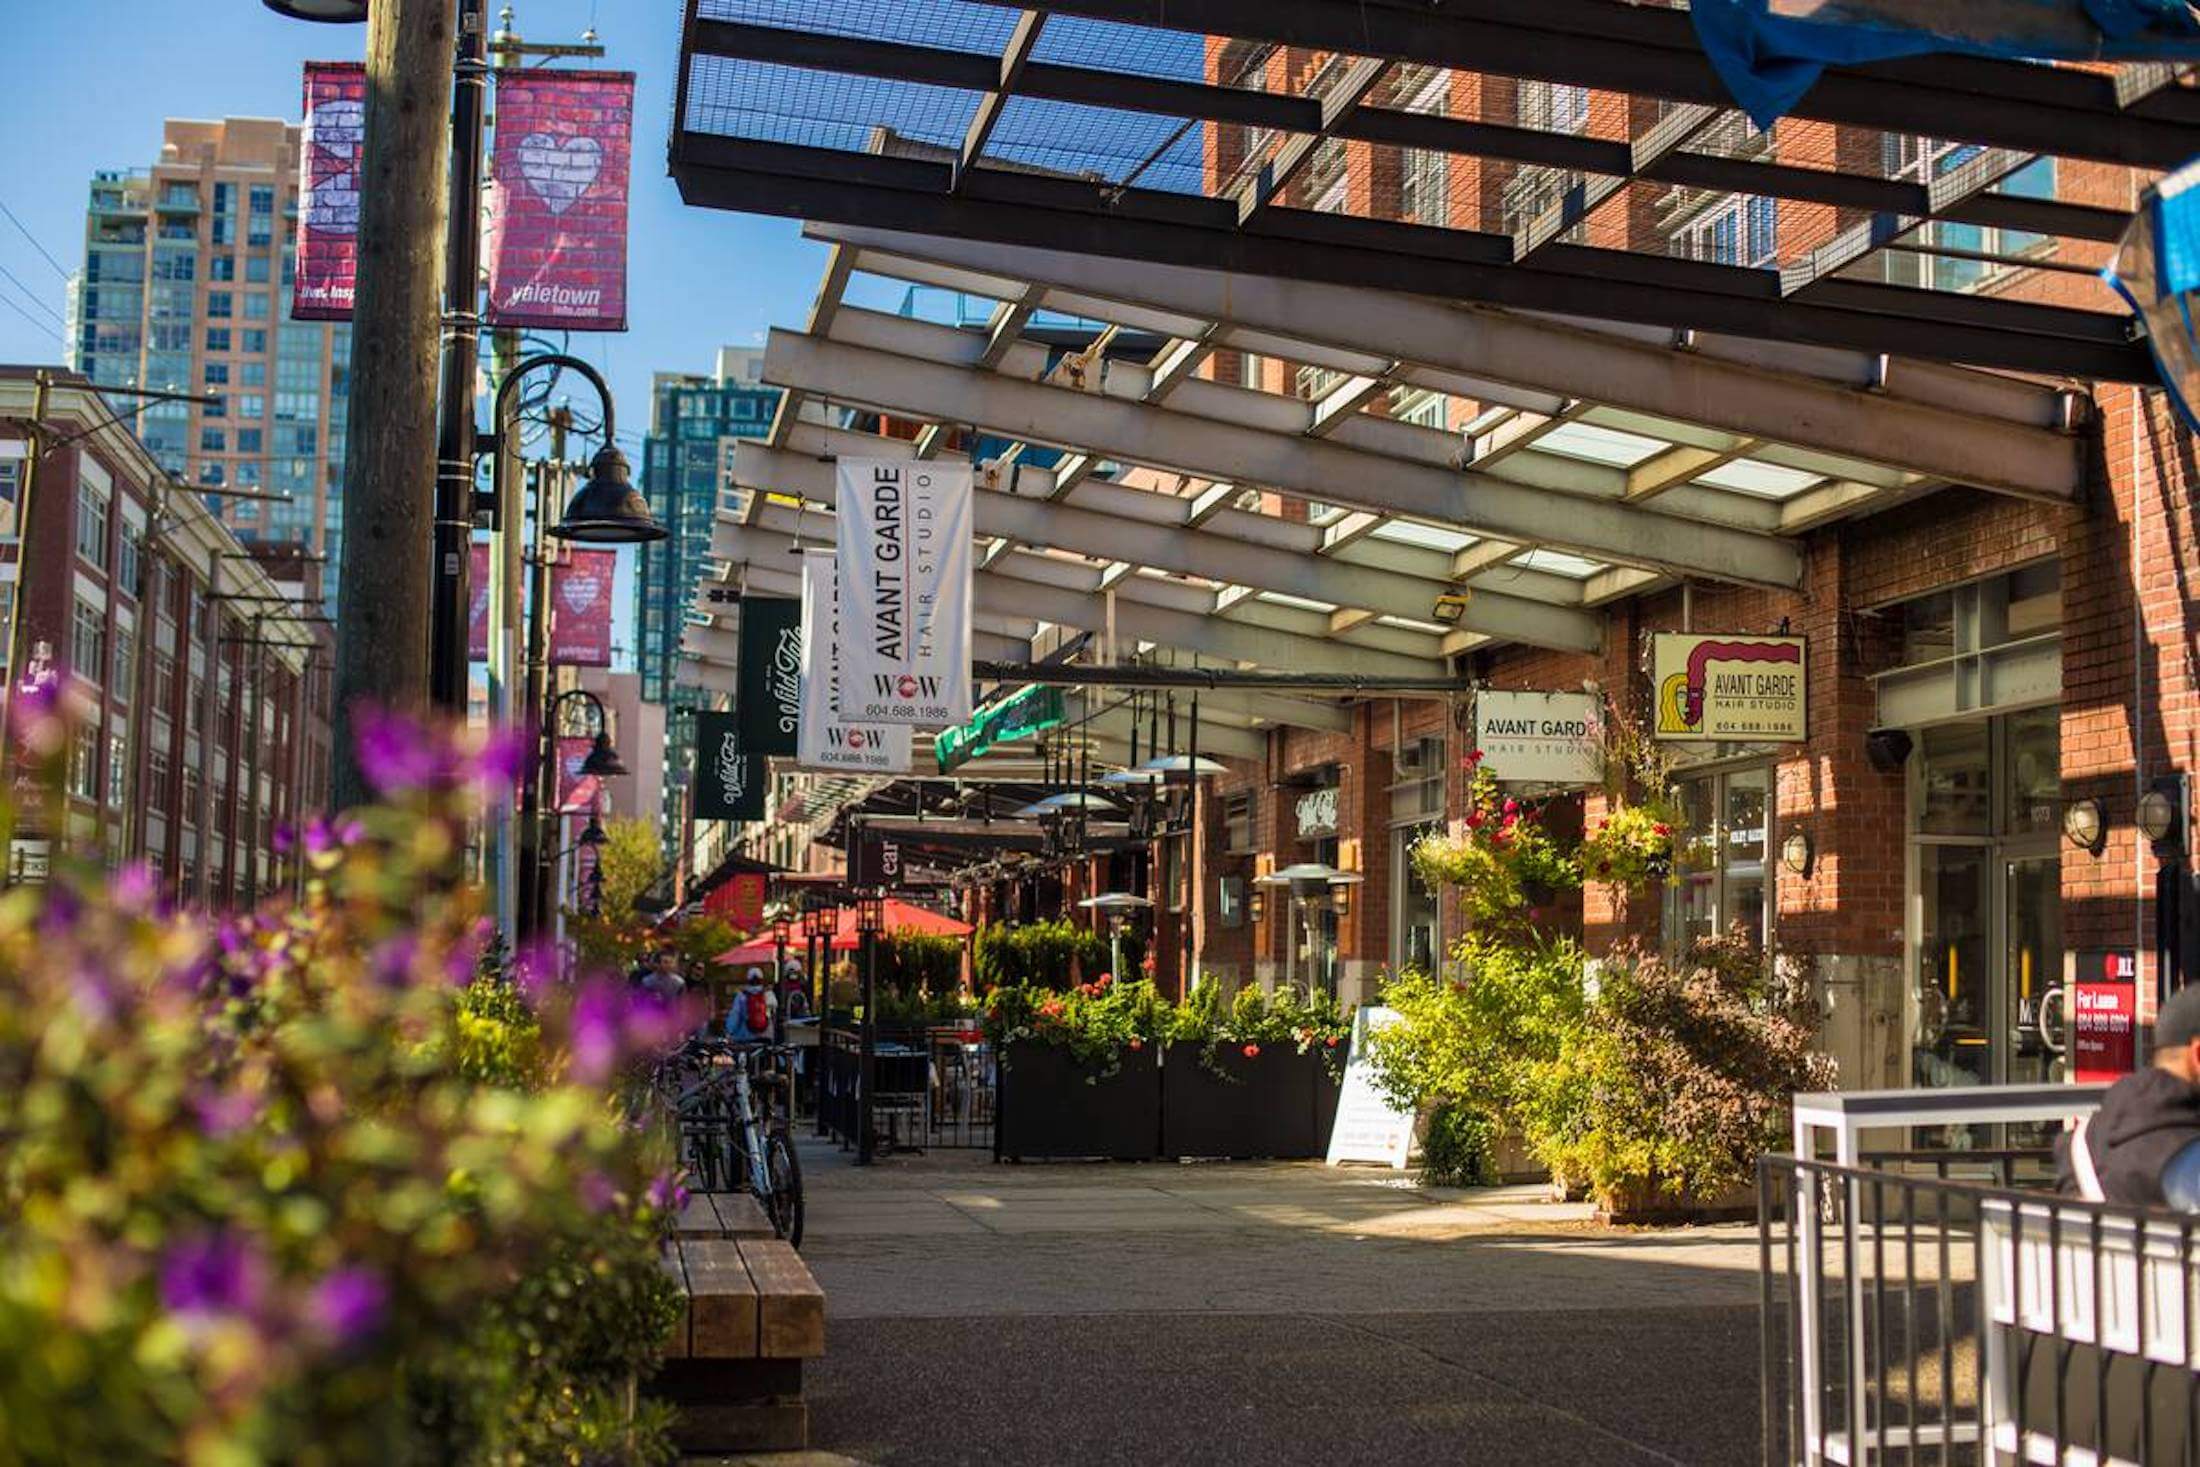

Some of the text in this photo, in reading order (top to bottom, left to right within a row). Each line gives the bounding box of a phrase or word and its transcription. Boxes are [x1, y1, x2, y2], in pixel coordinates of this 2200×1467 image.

[510, 283, 600, 307] yaletown
[874, 467, 901, 661] AVANT GARDE
[917, 473, 933, 657] HAIR STUDIO
[1715, 674, 1796, 696] AVANT GARDE
[865, 703, 949, 719] 604.688.1986
[1715, 700, 1795, 711] HAIR STUDIO
[1486, 718, 1588, 737] AVANT GARD
[1487, 744, 1525, 753] HAIR
